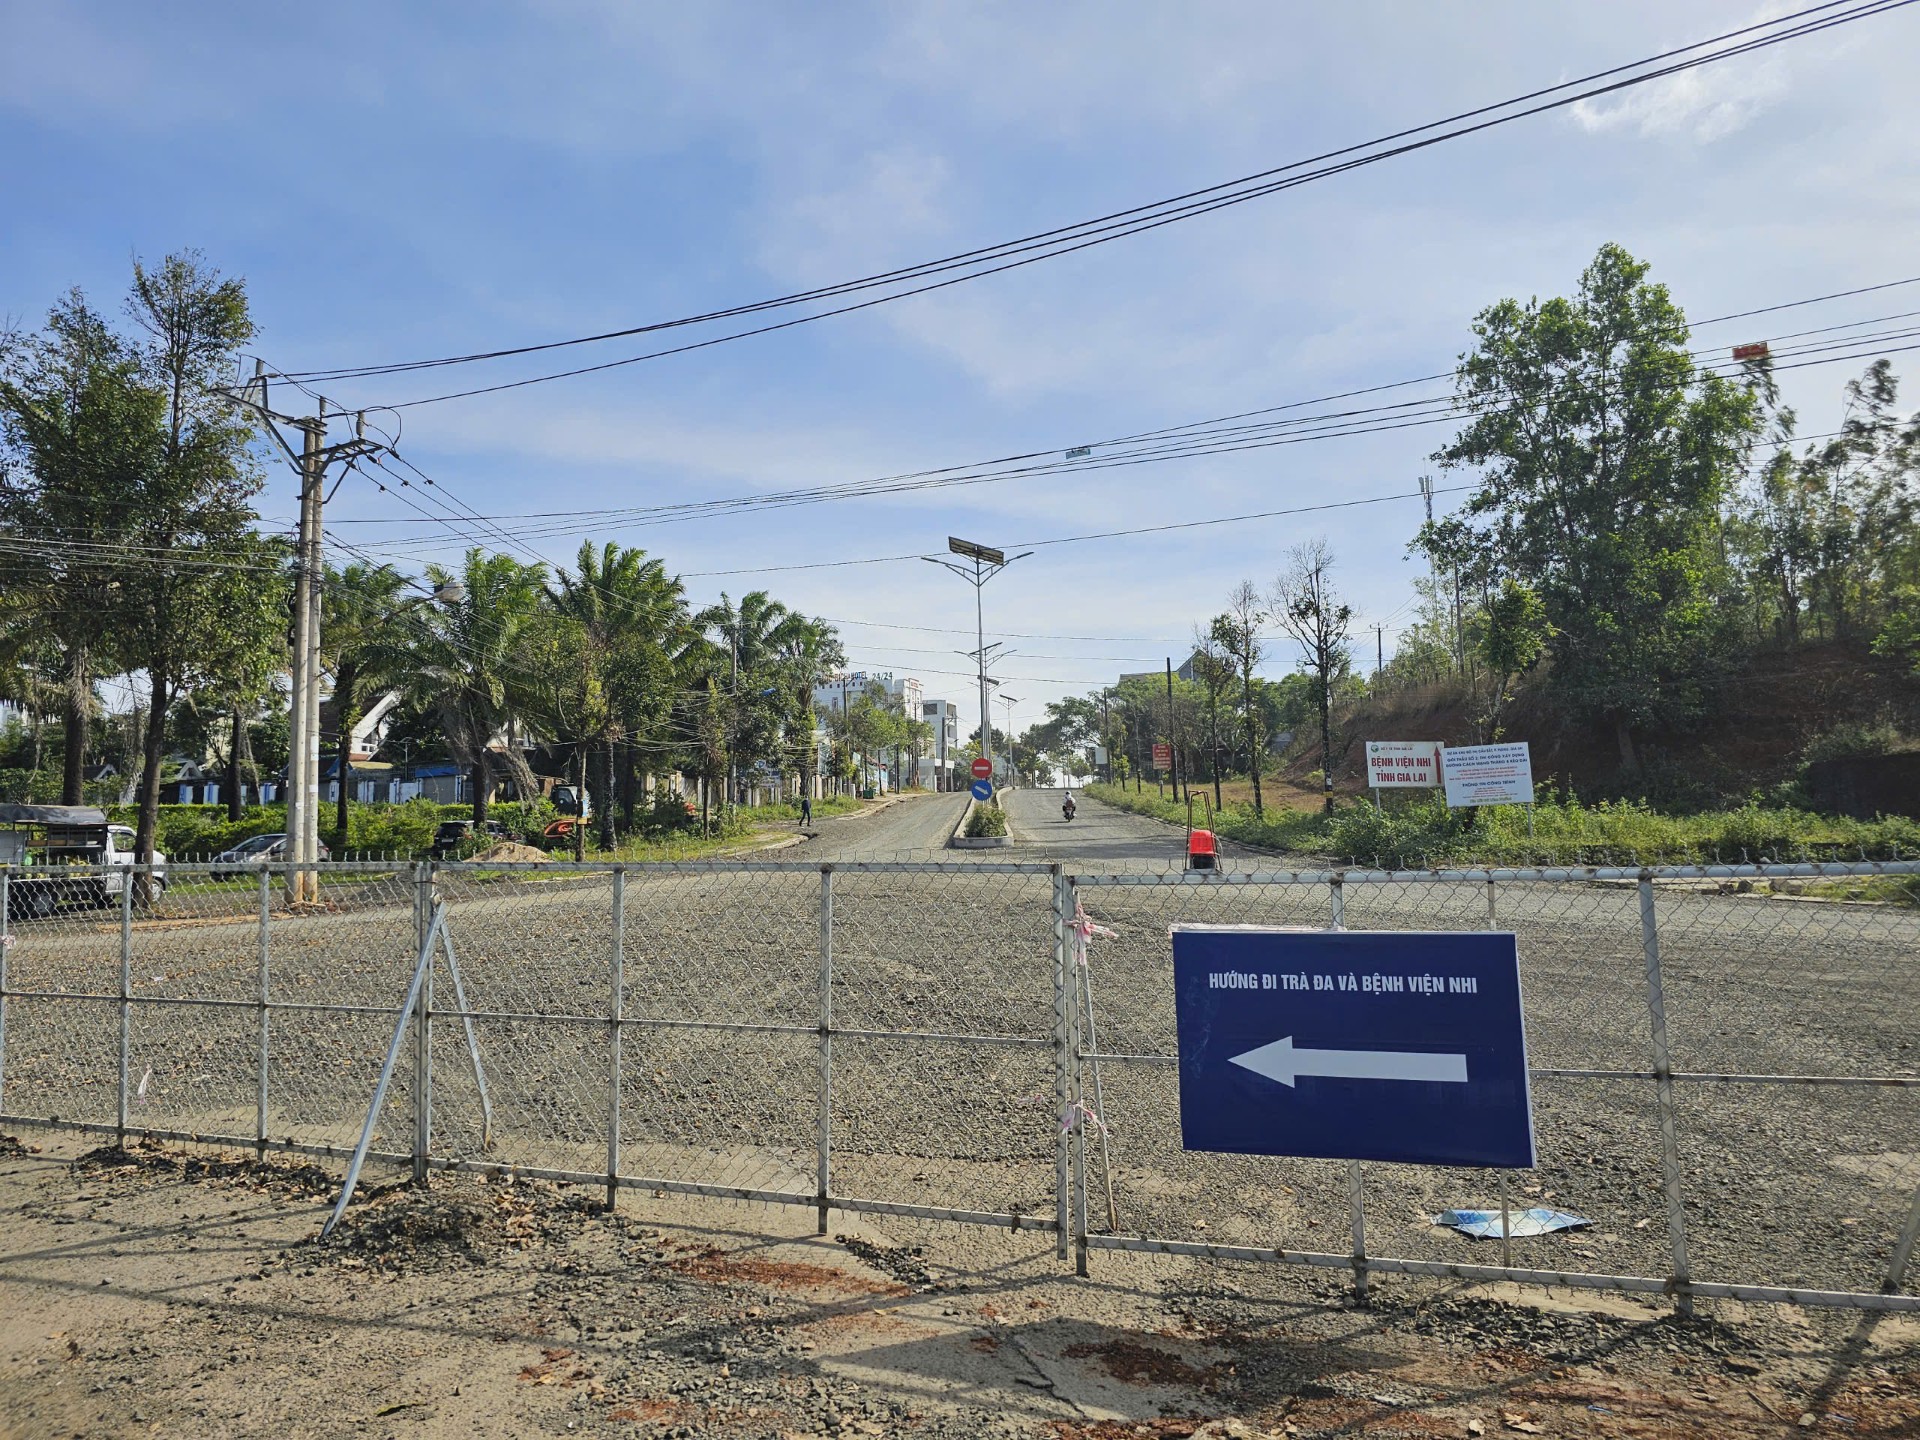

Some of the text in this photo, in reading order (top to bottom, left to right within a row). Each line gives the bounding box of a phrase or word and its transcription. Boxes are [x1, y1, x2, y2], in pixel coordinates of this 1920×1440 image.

[872, 671, 893, 682] 24/24
[1371, 756, 1431, 768] BỆNH VIỆN NHI
[1376, 770, 1426, 782] TỈNH GIA LAI
[1209, 970, 1478, 996] HƯỚNG ĐI TRÀ ĐA VÀ BỆNH VIỆN NHI
